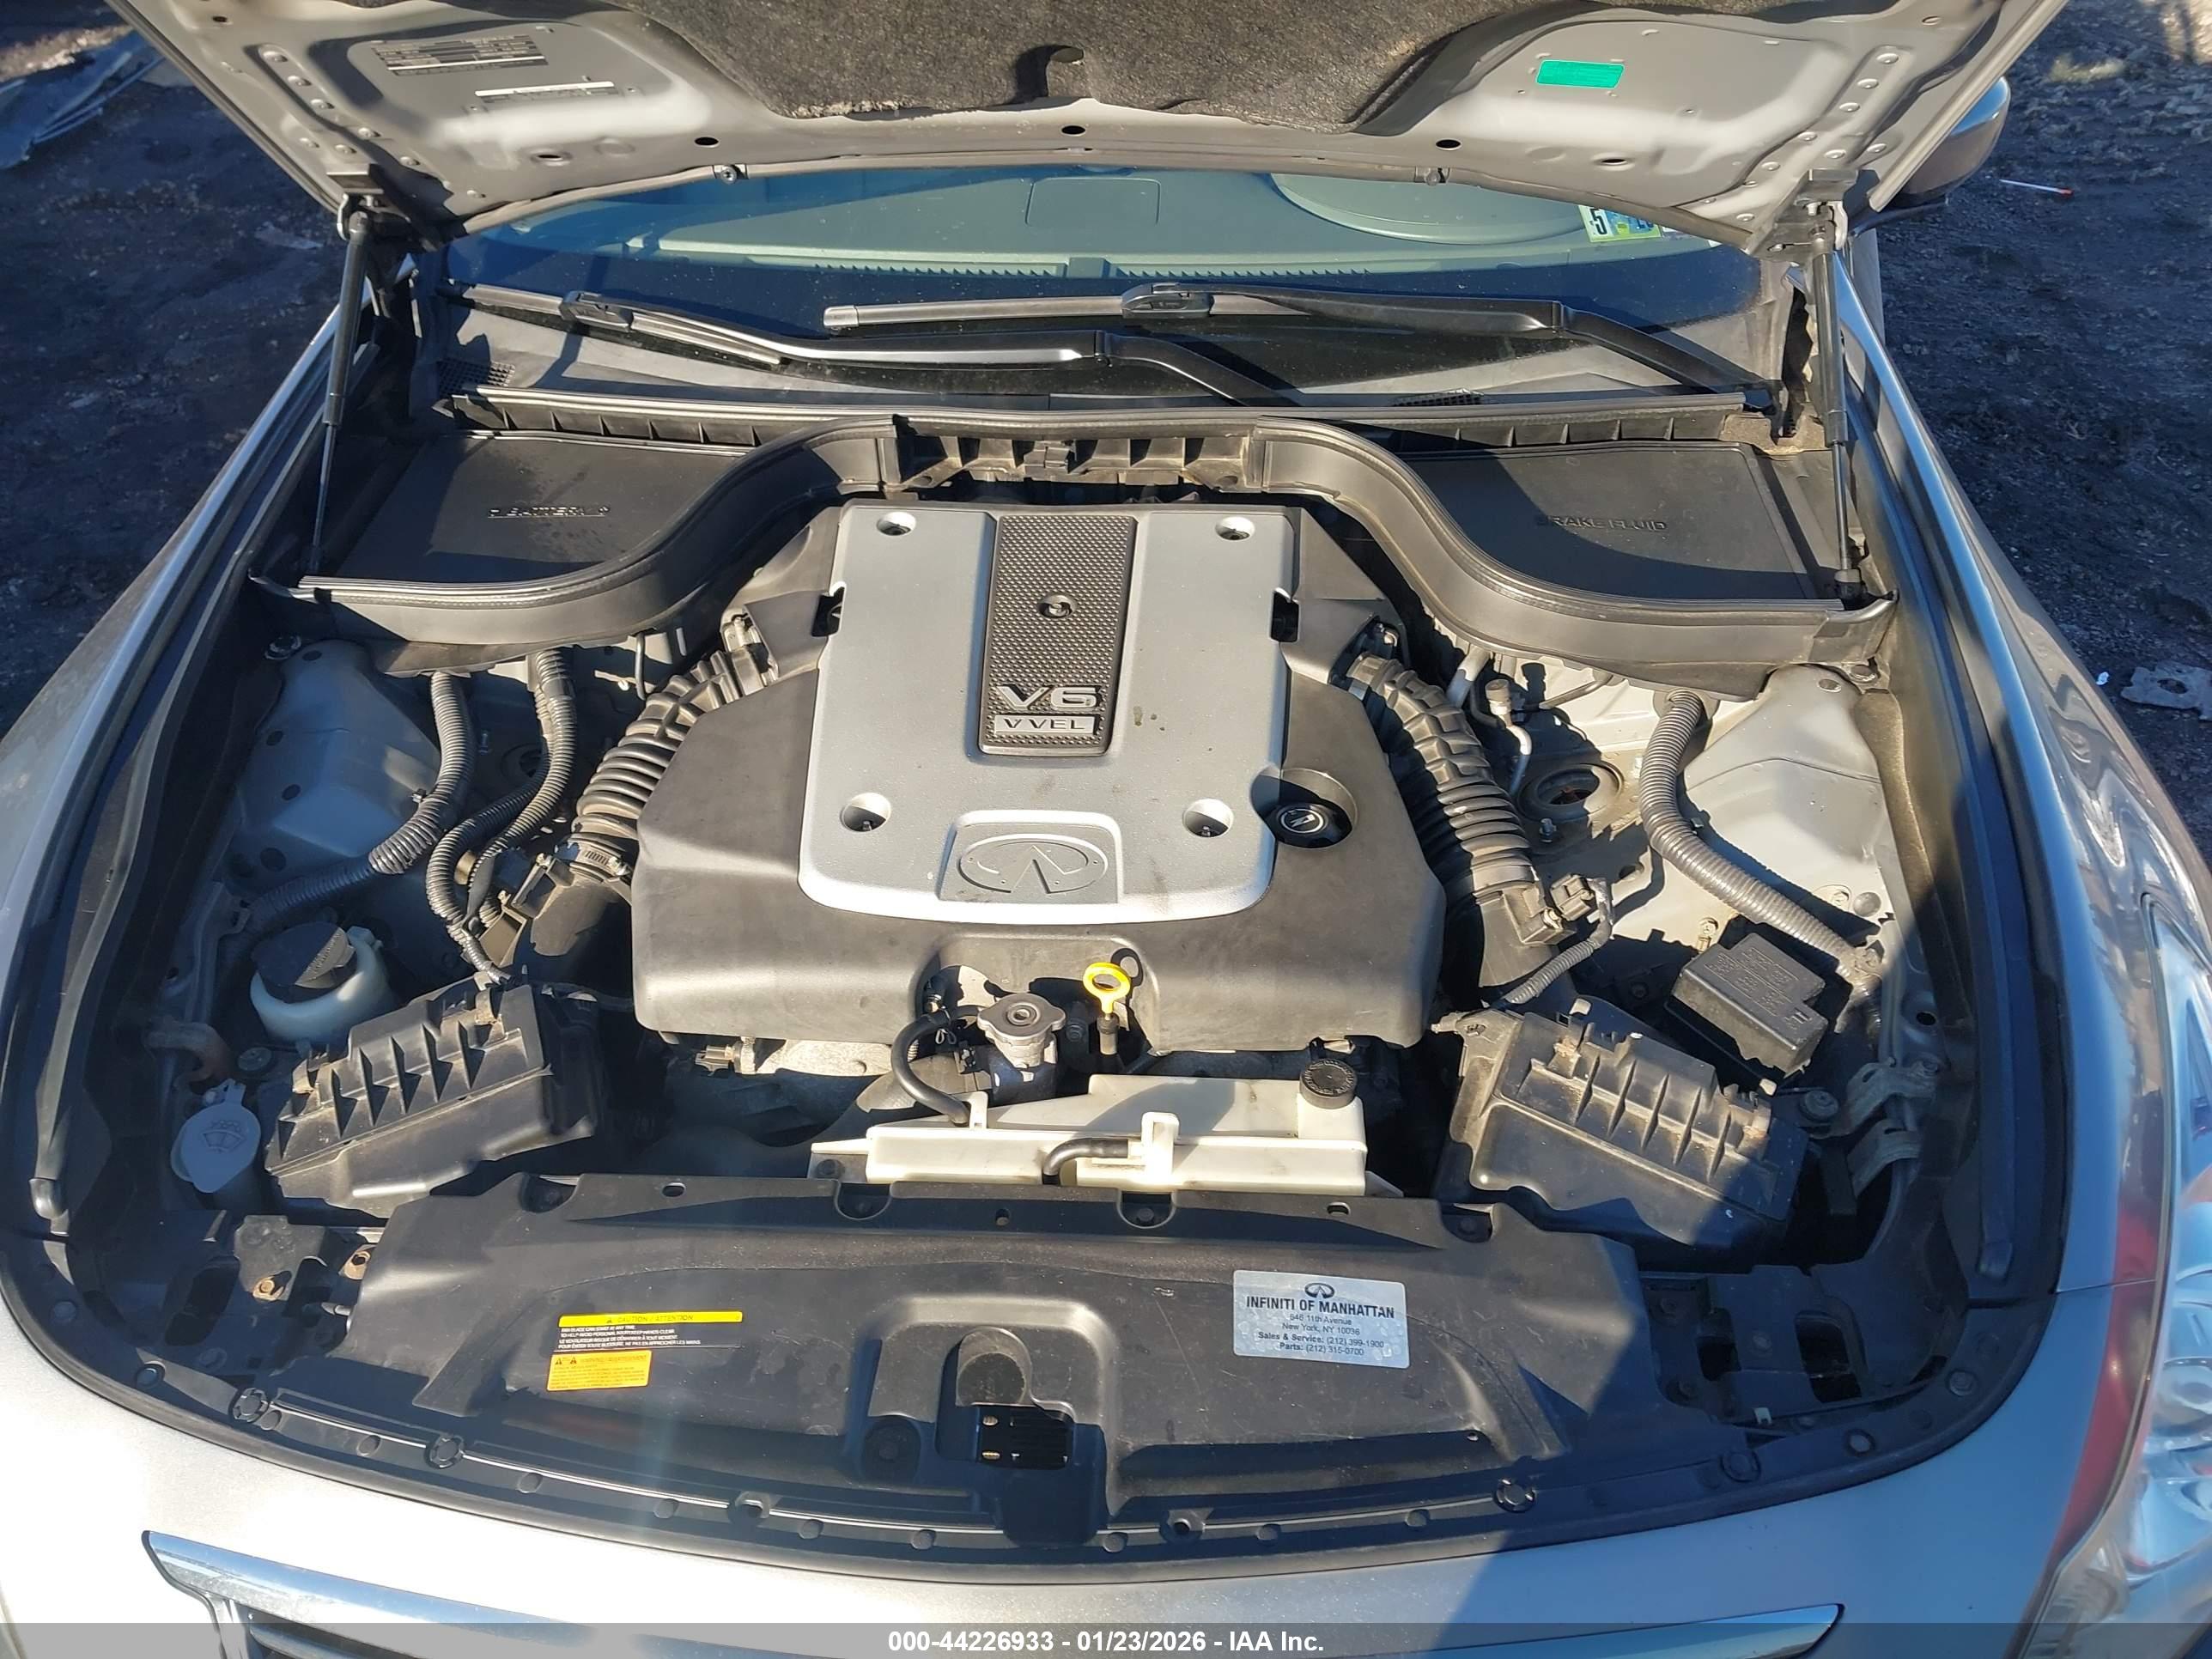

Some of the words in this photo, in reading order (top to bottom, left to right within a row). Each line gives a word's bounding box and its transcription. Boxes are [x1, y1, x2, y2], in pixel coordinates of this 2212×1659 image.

[996, 685, 1098, 710] V6
[1247, 1296, 1295, 1310] INFINITI
[1299, 1299, 1315, 1311] OF
[1319, 1302, 1395, 1319] MANHATTAN
[1323, 1316, 1352, 1326] Avenue
[1258, 1331, 1280, 1340] Sales
[1291, 1334, 1324, 1343] Service:
[1327, 1338, 1346, 1346] (212)
[1348, 1339, 1385, 1348] 399-1900
[1279, 1342, 1303, 1351] Parts:
[1306, 1345, 1326, 1353] (212)
